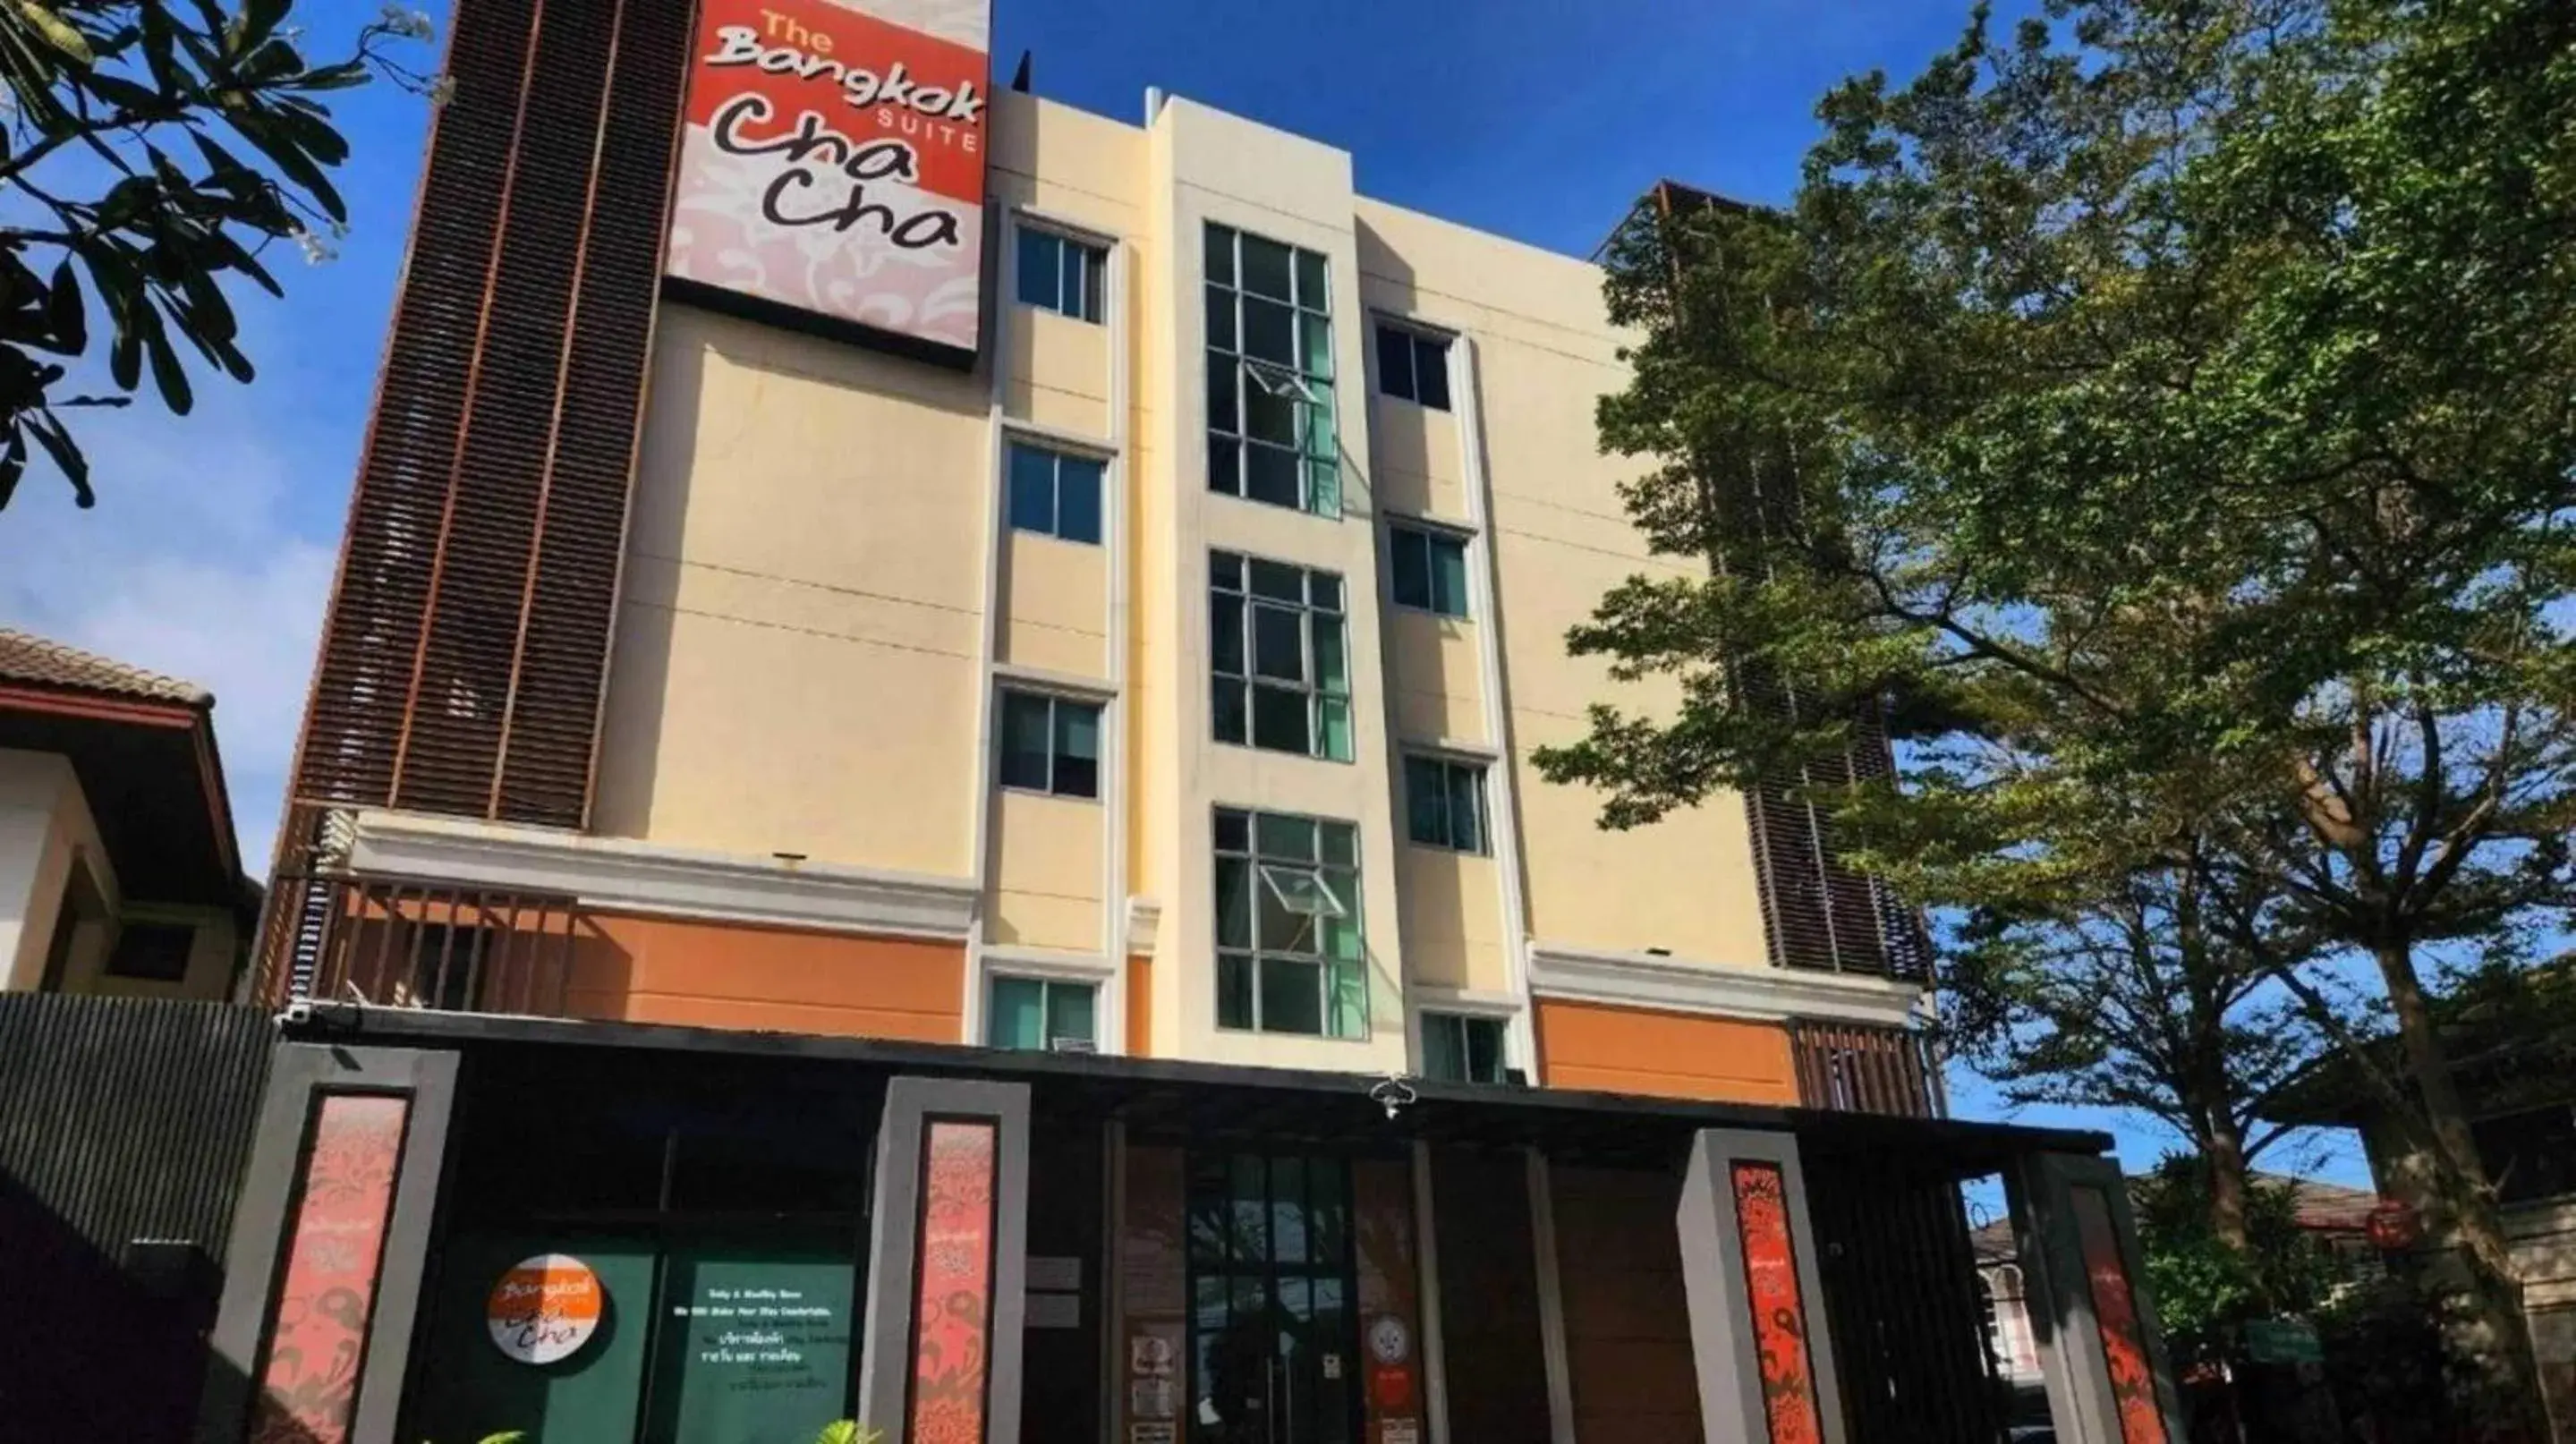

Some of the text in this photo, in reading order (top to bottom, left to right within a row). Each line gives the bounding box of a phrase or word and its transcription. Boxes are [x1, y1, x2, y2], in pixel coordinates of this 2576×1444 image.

[760, 8, 835, 53] The
[704, 26, 986, 123] Bangkok
[712, 96, 914, 181] Cha
[877, 107, 978, 153] SUITE
[762, 168, 959, 249] Cha
